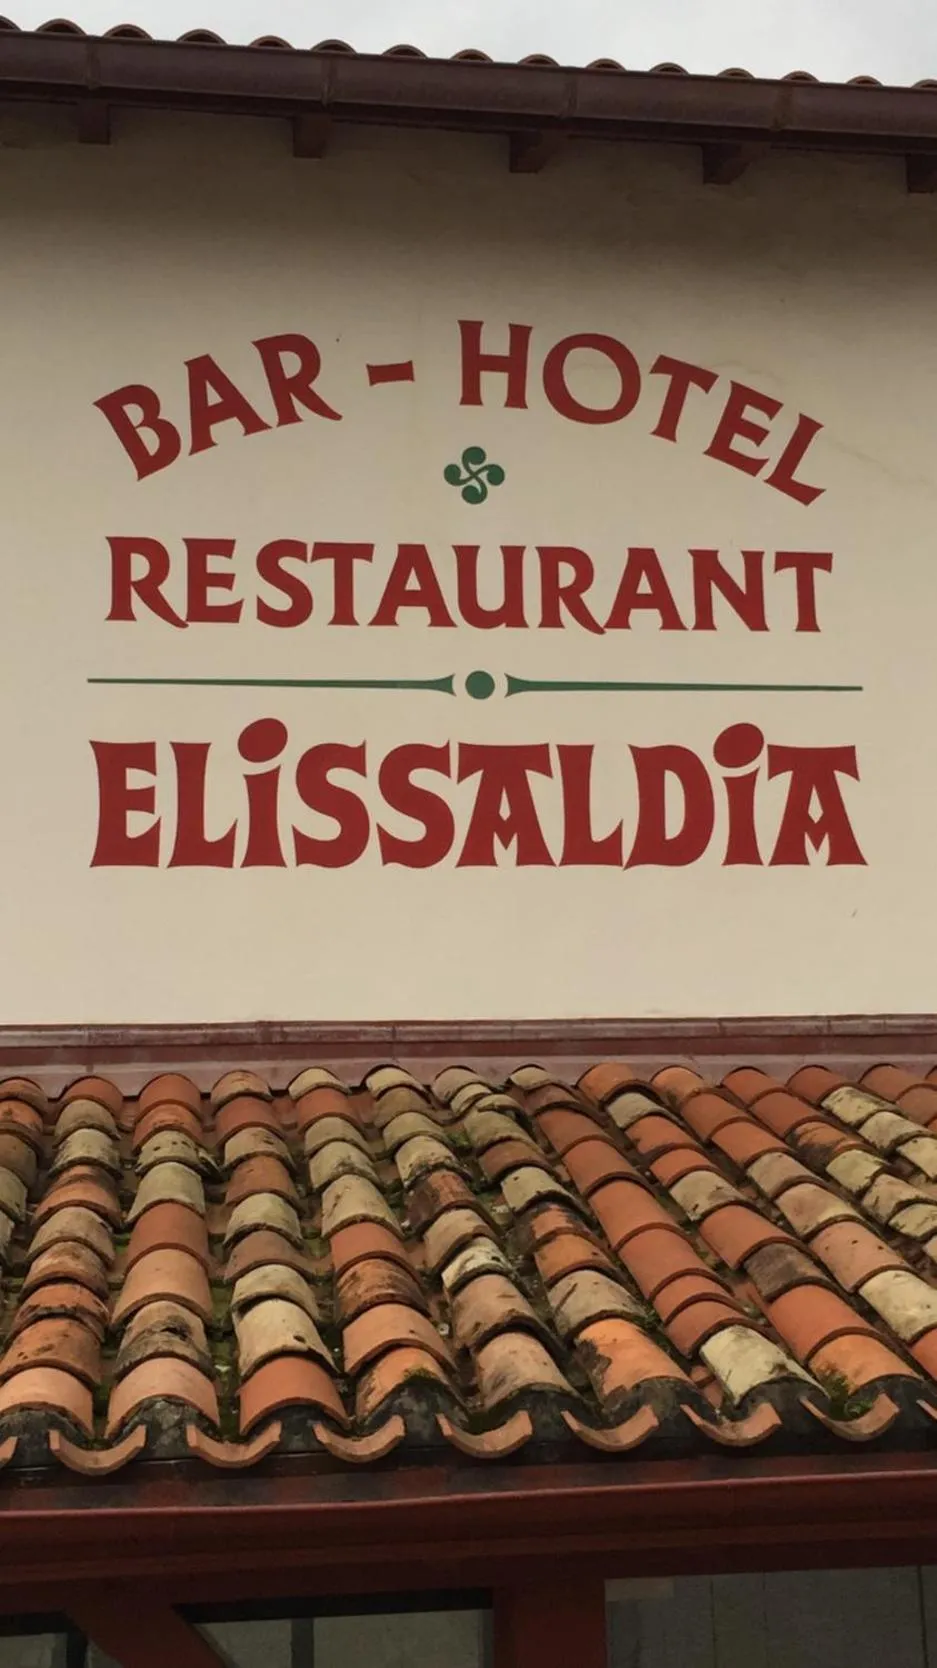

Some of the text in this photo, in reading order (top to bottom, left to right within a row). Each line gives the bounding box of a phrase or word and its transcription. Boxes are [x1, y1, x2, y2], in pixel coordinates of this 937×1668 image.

[94, 333, 343, 481] BAR
[458, 319, 827, 506] HOTEL
[105, 535, 834, 635] RESTAURANT
